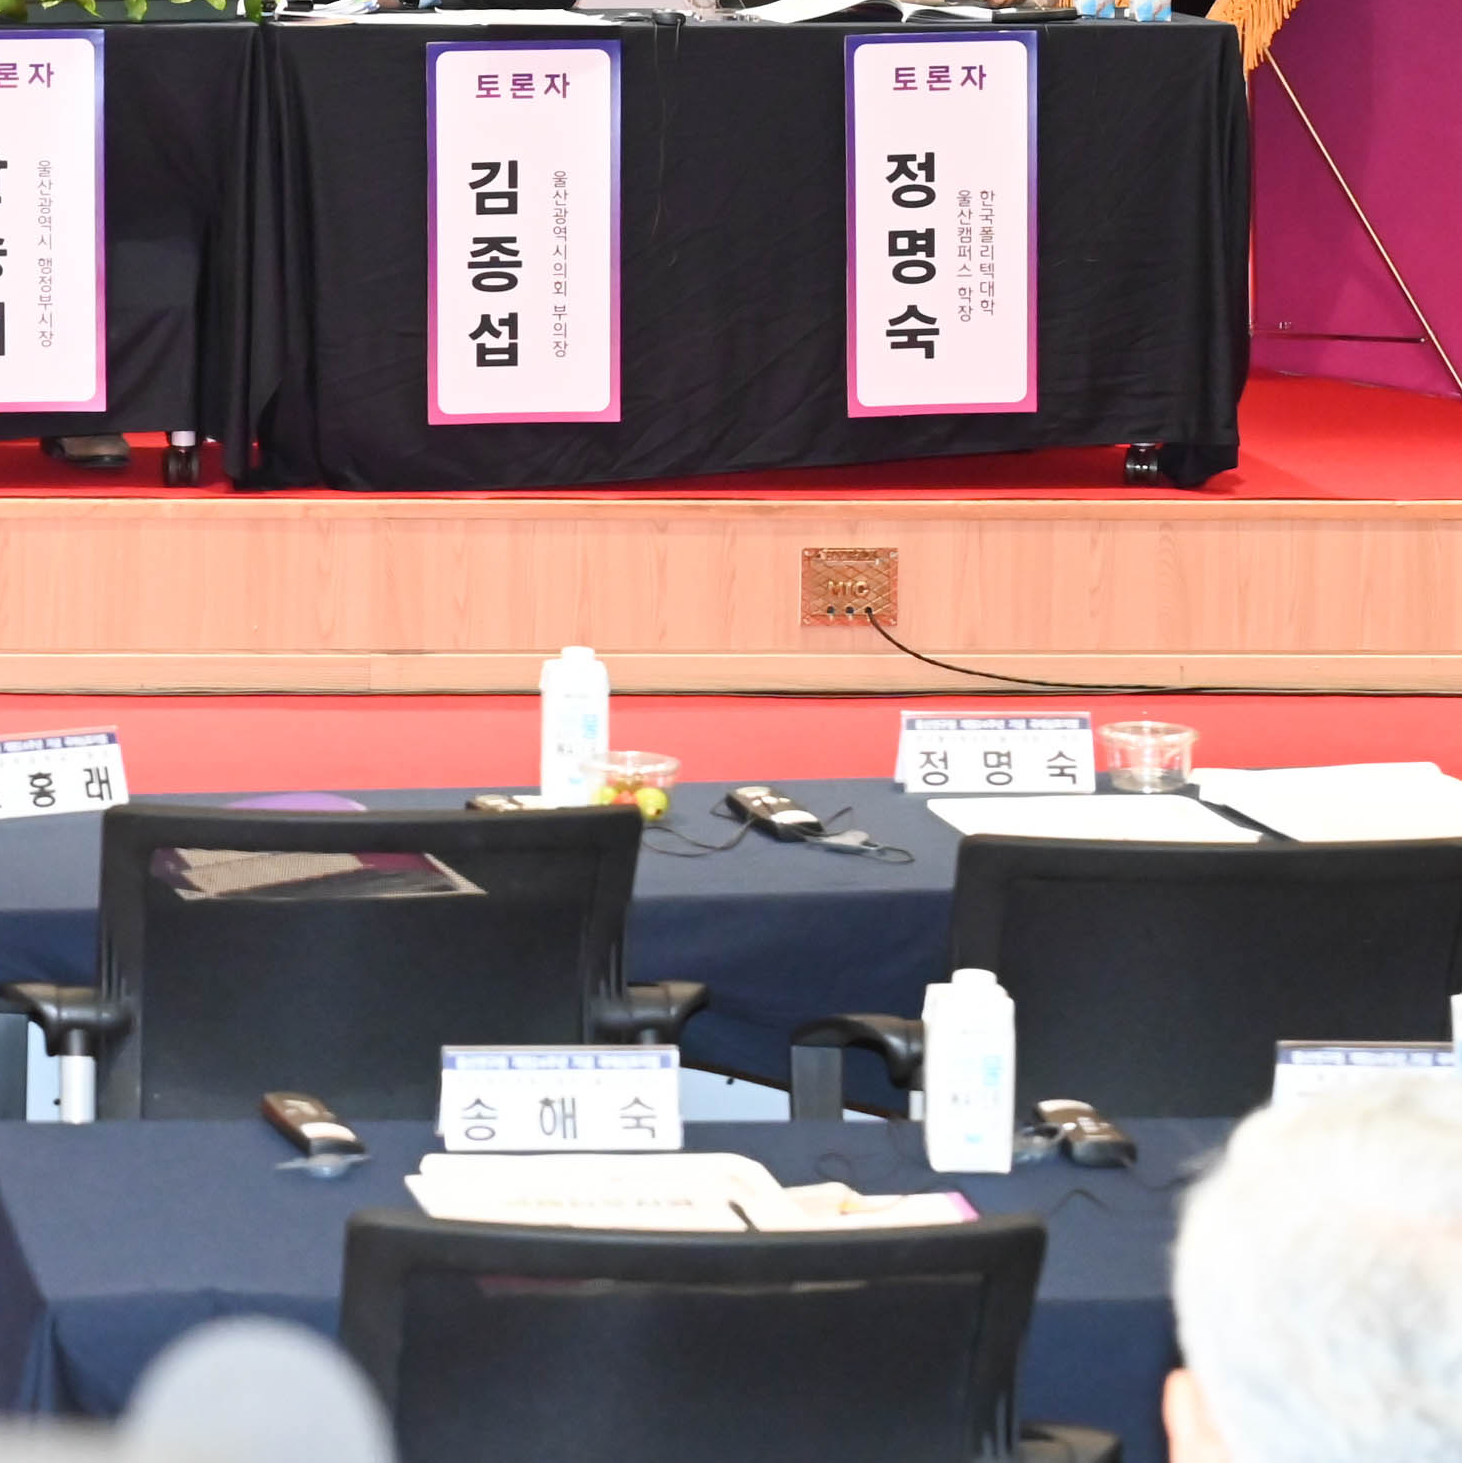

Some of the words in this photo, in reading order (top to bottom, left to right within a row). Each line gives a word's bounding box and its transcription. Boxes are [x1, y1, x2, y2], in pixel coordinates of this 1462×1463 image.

[476, 73, 570, 99] 토론자
[893, 65, 986, 91] 토론자
[37, 160, 53, 250] 울산광역시
[553, 171, 568, 296] 울산광역시의회
[957, 190, 972, 277] 울산캠퍼스
[468, 160, 522, 367] 김종섭
[886, 152, 939, 359] 정명숙
[979, 190, 995, 315] 한국폴리텍대학
[38, 258, 54, 347] 행정부시장
[552, 305, 568, 358] 부의장
[958, 287, 973, 322] 학장
[827, 579, 871, 600] MIC
[920, 751, 1076, 786] 정명숙
[464, 1097, 656, 1141] 송해숙
